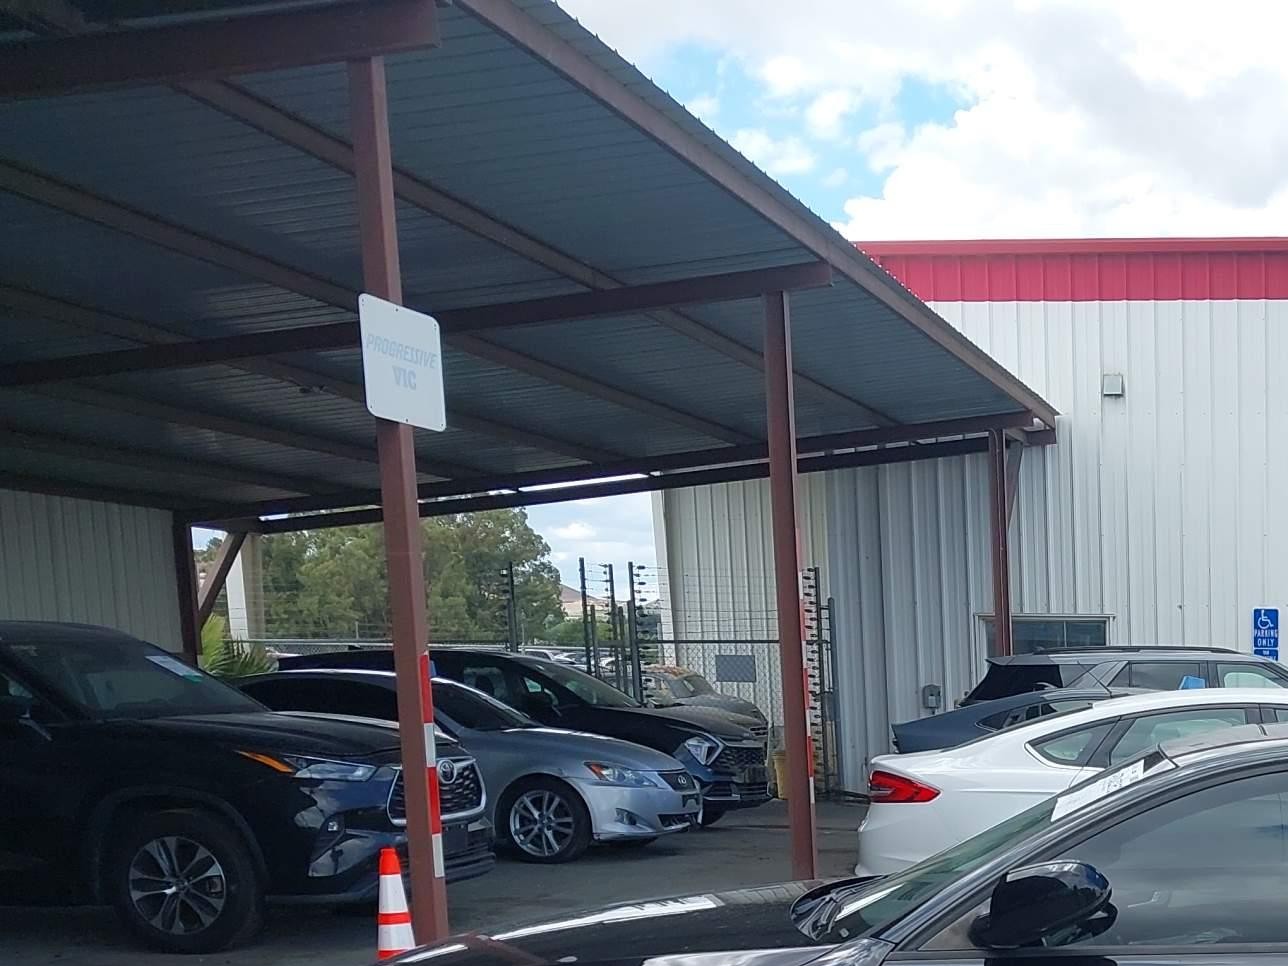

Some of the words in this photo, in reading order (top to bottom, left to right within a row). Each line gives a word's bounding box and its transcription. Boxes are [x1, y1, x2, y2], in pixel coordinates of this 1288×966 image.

[366, 333, 438, 369] PROGRESSIVE
[391, 365, 417, 391] VIC
[1257, 638, 1275, 647] ONLY
